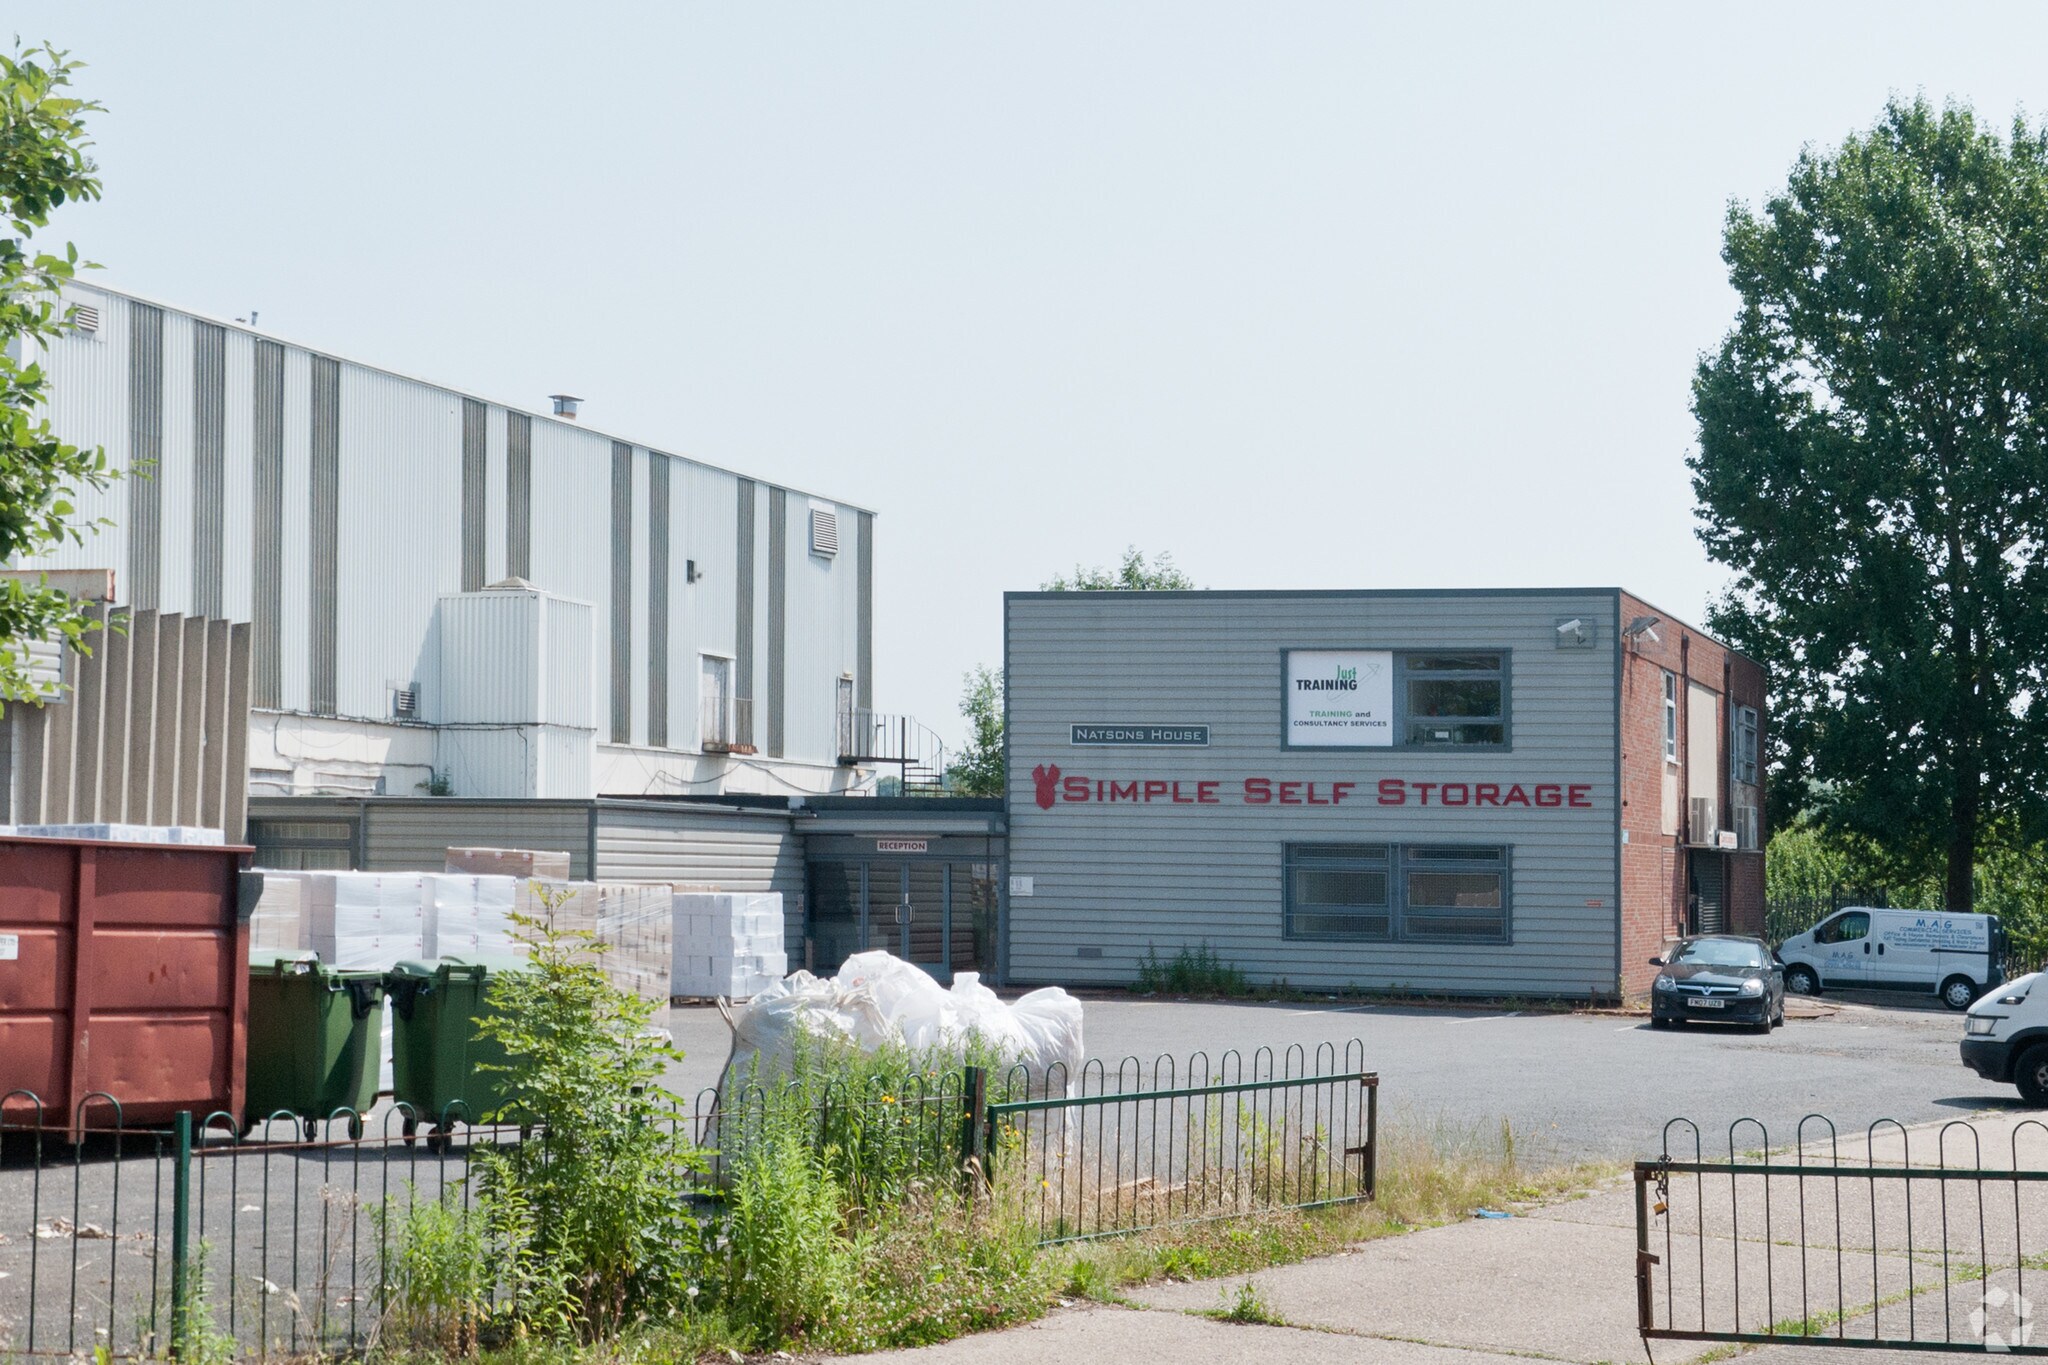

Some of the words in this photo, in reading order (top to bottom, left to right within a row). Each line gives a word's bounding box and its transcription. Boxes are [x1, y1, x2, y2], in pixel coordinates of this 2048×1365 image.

[1336, 664, 1357, 680] Just
[1296, 679, 1358, 691] TRAINING
[1310, 710, 1352, 718] TRAINING
[1076, 728, 1145, 740] NATSONS
[1151, 729, 1202, 741] HOUSE
[1062, 776, 1221, 803] SIMPLE
[1243, 778, 1355, 805] SELF
[1377, 779, 1593, 808] STORAGE
[879, 841, 926, 851] RECEPTION
[1899, 926, 1940, 934] COMMERCIAL
